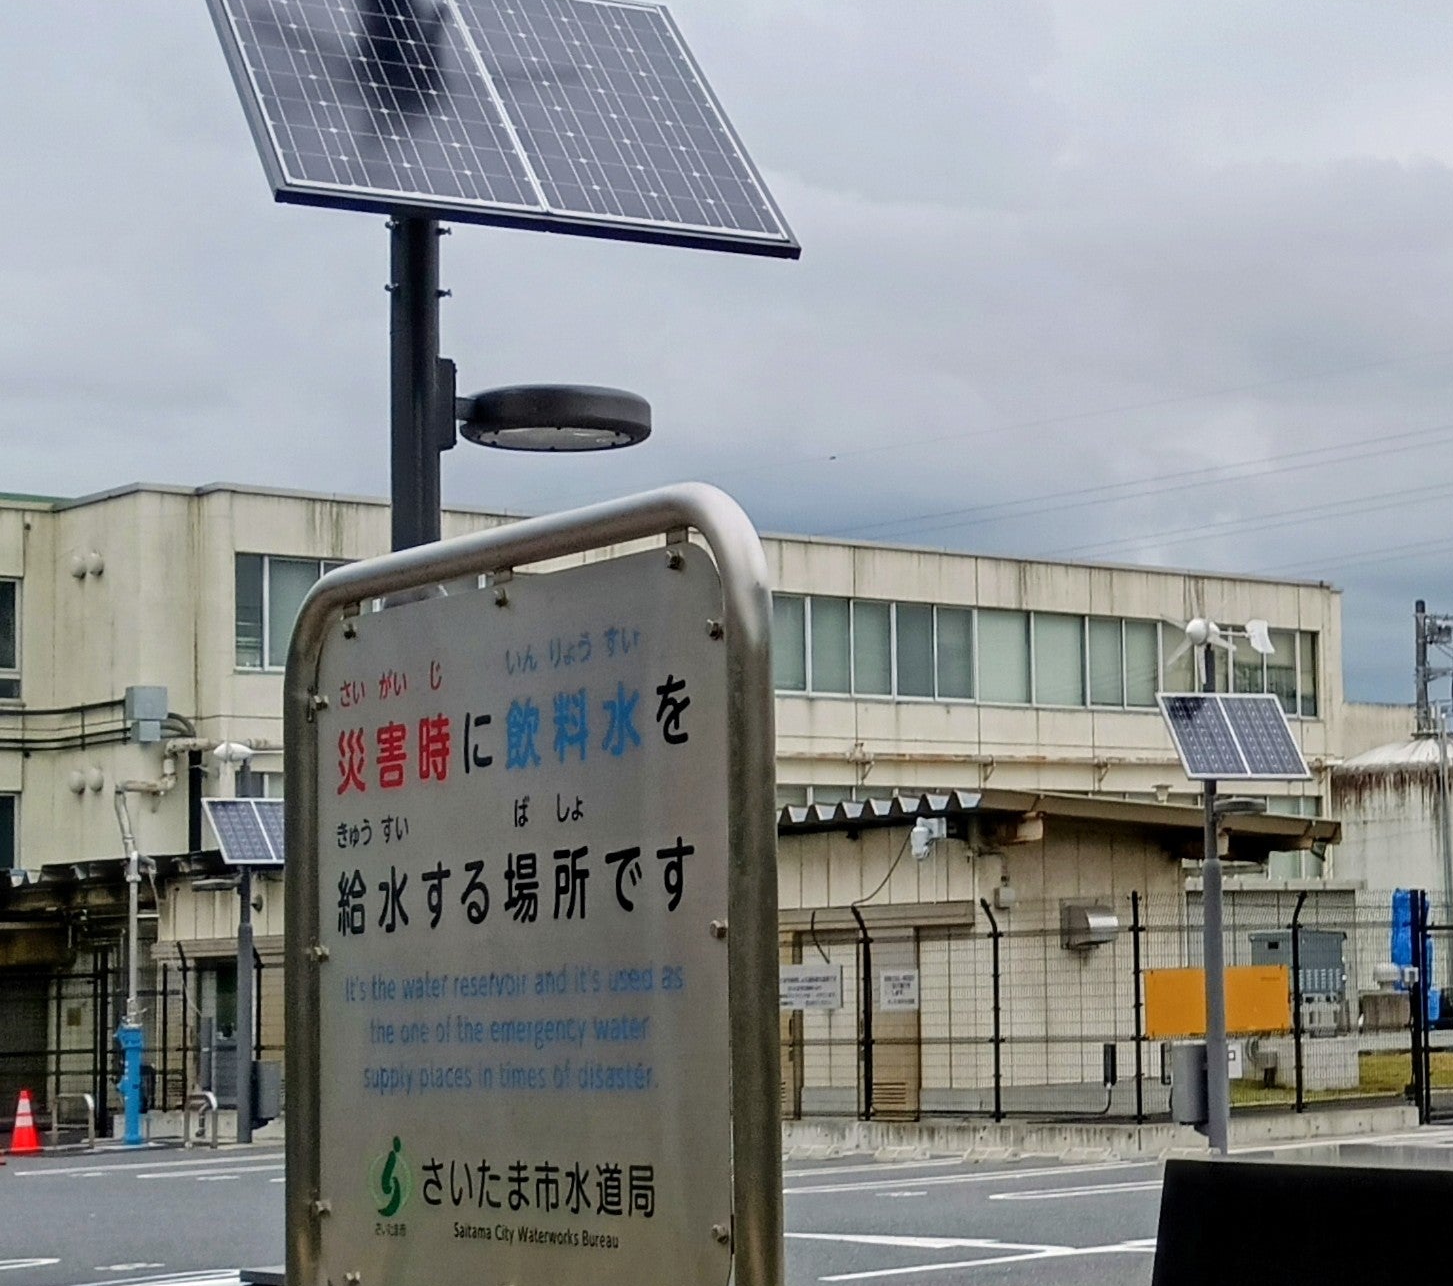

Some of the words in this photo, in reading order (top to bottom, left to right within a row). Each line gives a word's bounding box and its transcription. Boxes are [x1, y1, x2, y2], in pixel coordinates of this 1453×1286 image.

[337, 674, 691, 795] 災害時に飲料水を
[514, 796, 529, 827] ば
[556, 794, 583, 824] しょ
[337, 818, 372, 849] きゅう
[381, 815, 409, 844] すい
[337, 836, 695, 937] 給水する場所です
[345, 975, 366, 1001] It's
[372, 973, 396, 1000] the
[403, 971, 448, 999] water
[454, 970, 527, 998] reservoir
[535, 964, 566, 994] and
[609, 965, 653, 992] used
[662, 965, 683, 991] as
[370, 1018, 395, 1044] the
[401, 1021, 430, 1043] one
[436, 1016, 451, 1043] of
[457, 1015, 484, 1043] the
[490, 1017, 587, 1050] emergency
[593, 1015, 650, 1041] water
[363, 1065, 413, 1095] supply
[420, 1065, 472, 1094] places
[479, 1063, 493, 1089] in
[500, 1062, 546, 1089] times
[553, 1059, 569, 1089] of
[578, 1060, 659, 1090] disaster.
[421, 1158, 656, 1219] さいたま市水道局
[453, 1222, 492, 1241] Saitama
[494, 1225, 515, 1247] City
[517, 1226, 579, 1247] Waterworks
[582, 1230, 619, 1249] Bureau
